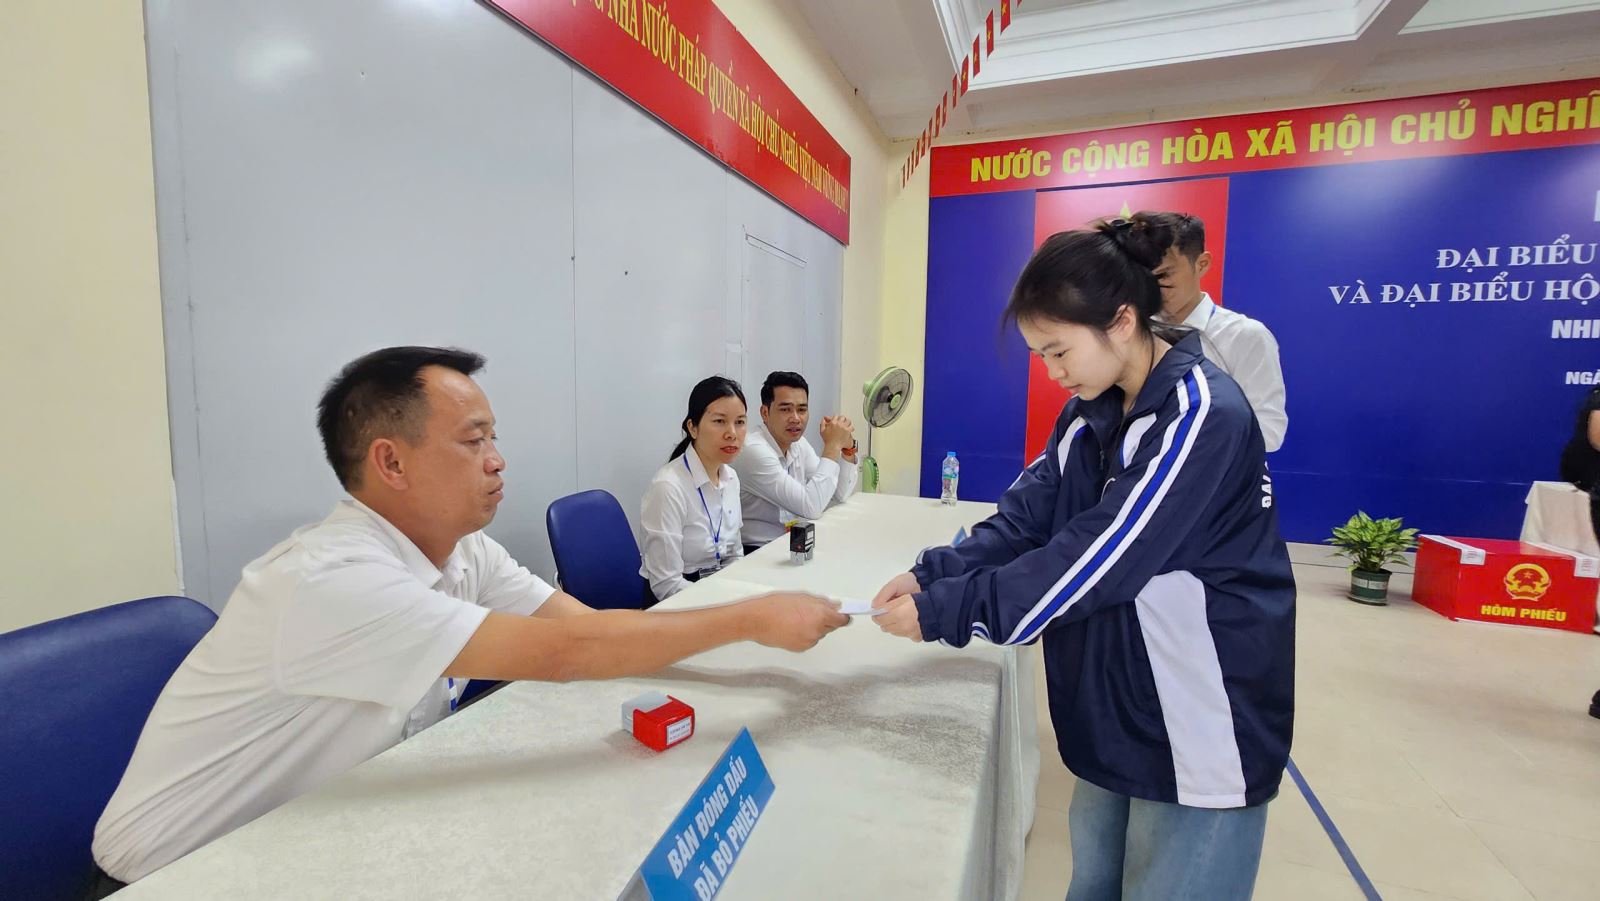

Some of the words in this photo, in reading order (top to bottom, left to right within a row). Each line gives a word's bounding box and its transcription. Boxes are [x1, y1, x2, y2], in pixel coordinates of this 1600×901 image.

[641, 0, 676, 72] NƯỚC
[678, 33, 707, 96] PHÁP
[751, 94, 765, 153] HỘI
[970, 147, 1052, 183] NƯỚC
[1062, 140, 1150, 177] CỘNG
[1162, 128, 1234, 165] HÒA
[1245, 120, 1297, 158] XÃ
[1309, 113, 1377, 156] HỘI
[1390, 98, 1476, 145] CHỦ
[1327, 279, 1372, 305] VÀ
[1380, 282, 1442, 308] ĐẠI
[1448, 271, 1535, 302] BIỂU
[1542, 273, 1600, 305] HỘ
[1436, 247, 1501, 273] ĐẠI
[1507, 233, 1599, 266] BIỂU
[1519, 607, 1567, 622] PHIẾU
[667, 834, 700, 880] BÀN
[694, 783, 729, 840] ĐÓNG
[723, 755, 747, 797] DẤU
[693, 860, 720, 901] ĐÃ
[711, 832, 733, 878] BỎ
[726, 794, 759, 852] PHIẾU
